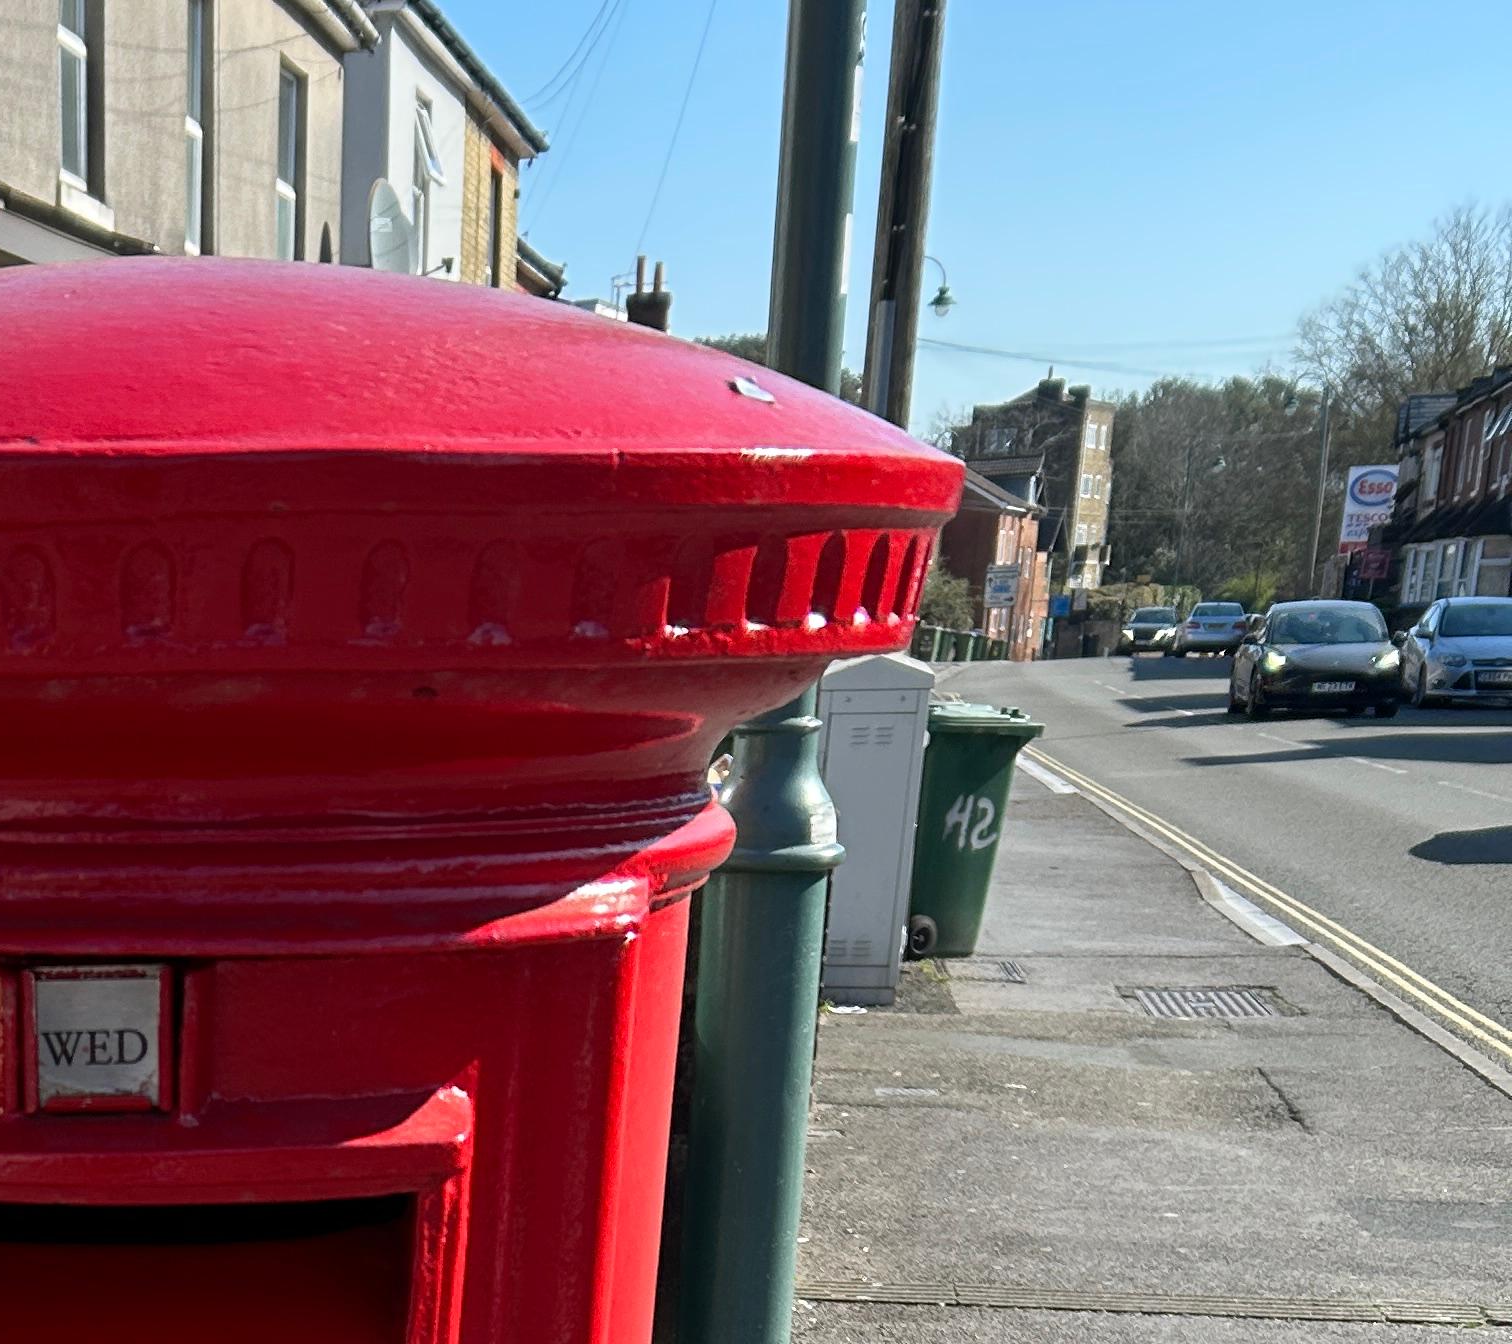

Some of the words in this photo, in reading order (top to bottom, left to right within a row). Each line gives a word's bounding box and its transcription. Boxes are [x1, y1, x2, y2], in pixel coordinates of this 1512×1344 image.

[1358, 480, 1394, 496] Esso
[1346, 512, 1388, 523] TESCO
[942, 794, 998, 851] 42
[41, 1027, 149, 1067] WED
